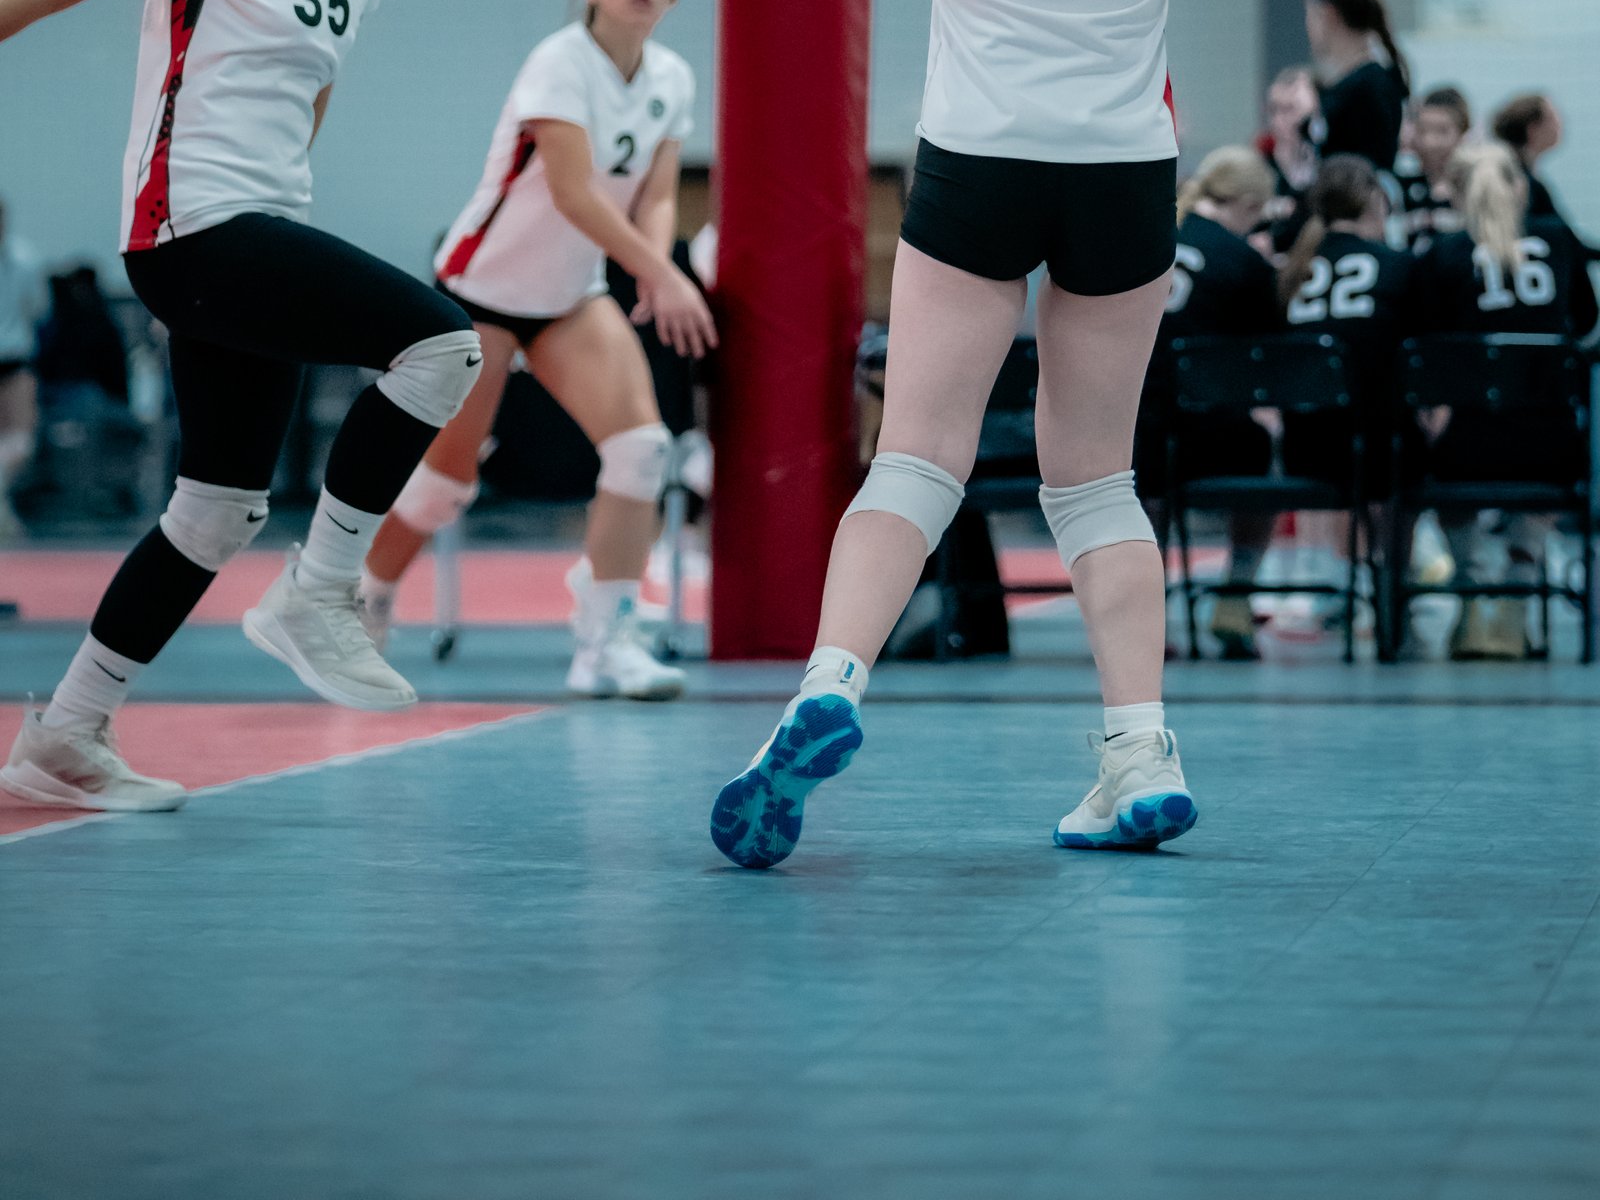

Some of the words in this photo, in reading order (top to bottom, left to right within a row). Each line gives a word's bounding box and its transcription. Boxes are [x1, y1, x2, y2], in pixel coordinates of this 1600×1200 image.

[610, 134, 635, 176] 2
[1287, 253, 1379, 324] 22
[1472, 236, 1556, 311] 16
